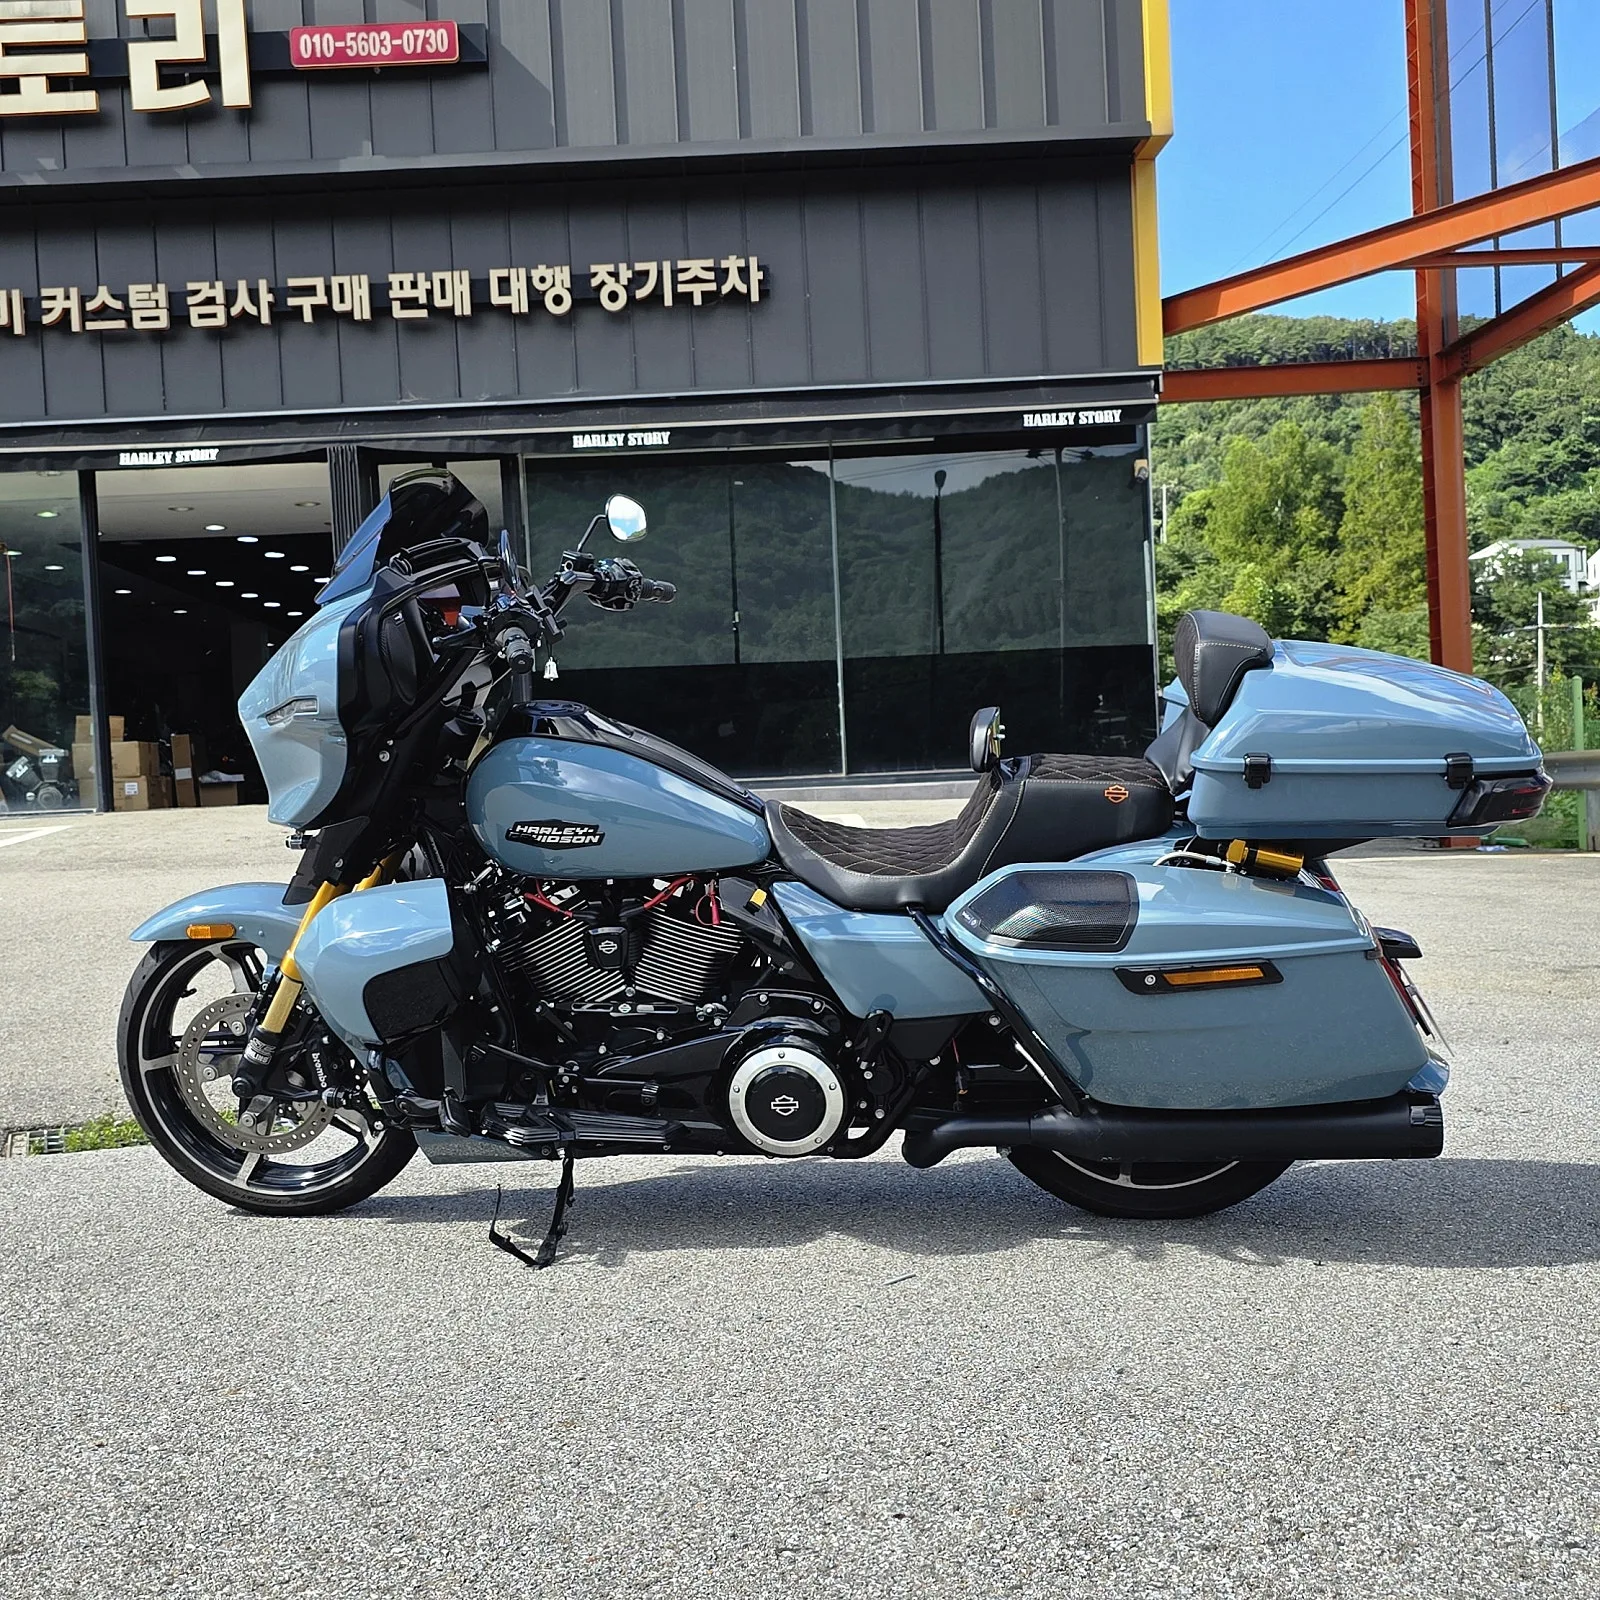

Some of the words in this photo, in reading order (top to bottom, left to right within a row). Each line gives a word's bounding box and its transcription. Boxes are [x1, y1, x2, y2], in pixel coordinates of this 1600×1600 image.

[300, 28, 449, 59] 010-5603-0730
[40, 283, 170, 332] 커스텀
[186, 279, 275, 328] 검사
[286, 274, 372, 323] 구매
[388, 269, 472, 319] 판매
[489, 264, 572, 316] 대행
[590, 254, 764, 313] 장기주차
[1023, 412, 1076, 427] HARLEY
[1078, 409, 1122, 425] STORY
[572, 433, 625, 448] HARLEY
[627, 431, 670, 446] STORY
[119, 451, 173, 465] HARLEY
[175, 448, 219, 463] STORY
[509, 831, 600, 844] VIDSON
